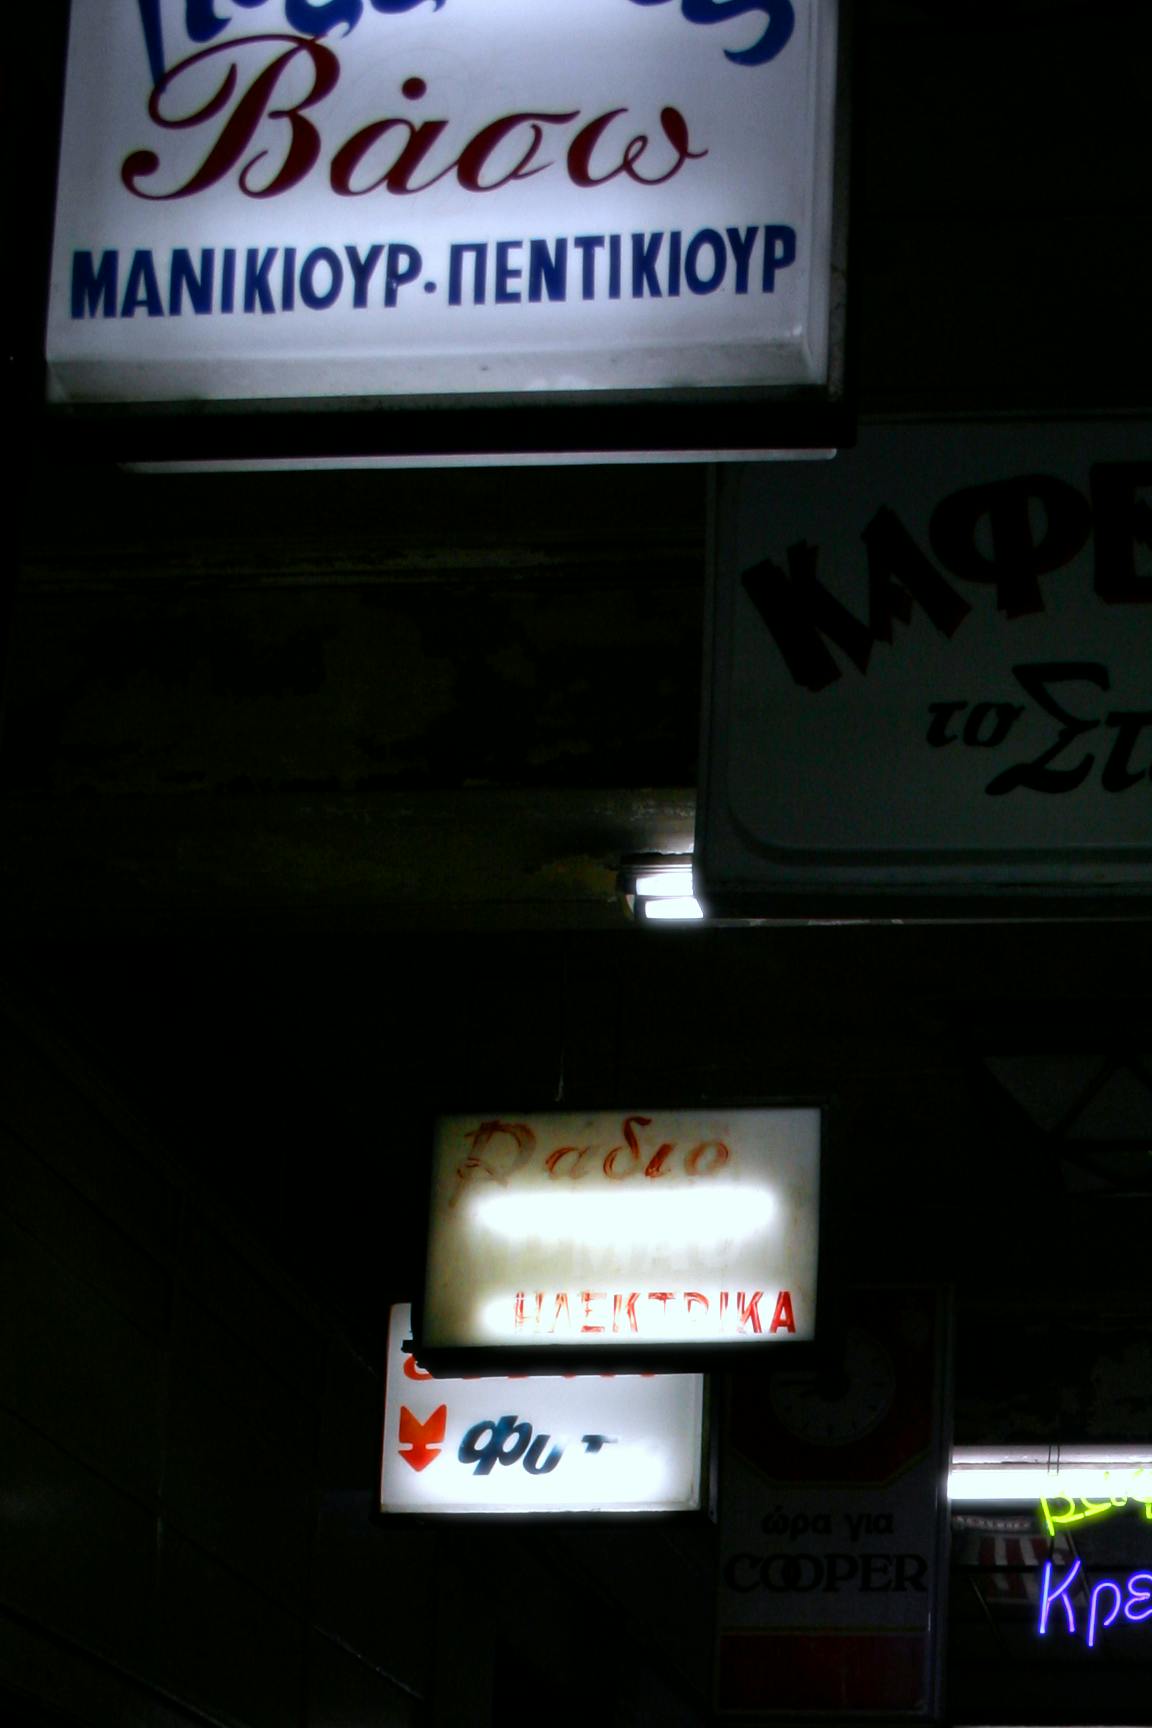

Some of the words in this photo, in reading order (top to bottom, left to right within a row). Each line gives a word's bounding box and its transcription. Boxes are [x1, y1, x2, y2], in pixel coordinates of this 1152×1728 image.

[121, 33, 709, 201] Βάσω
[925, 700, 1023, 749] το
[762, 1505, 832, 1541] ώρα
[845, 1513, 893, 1541] για
[725, 1553, 928, 1593] COOPER
